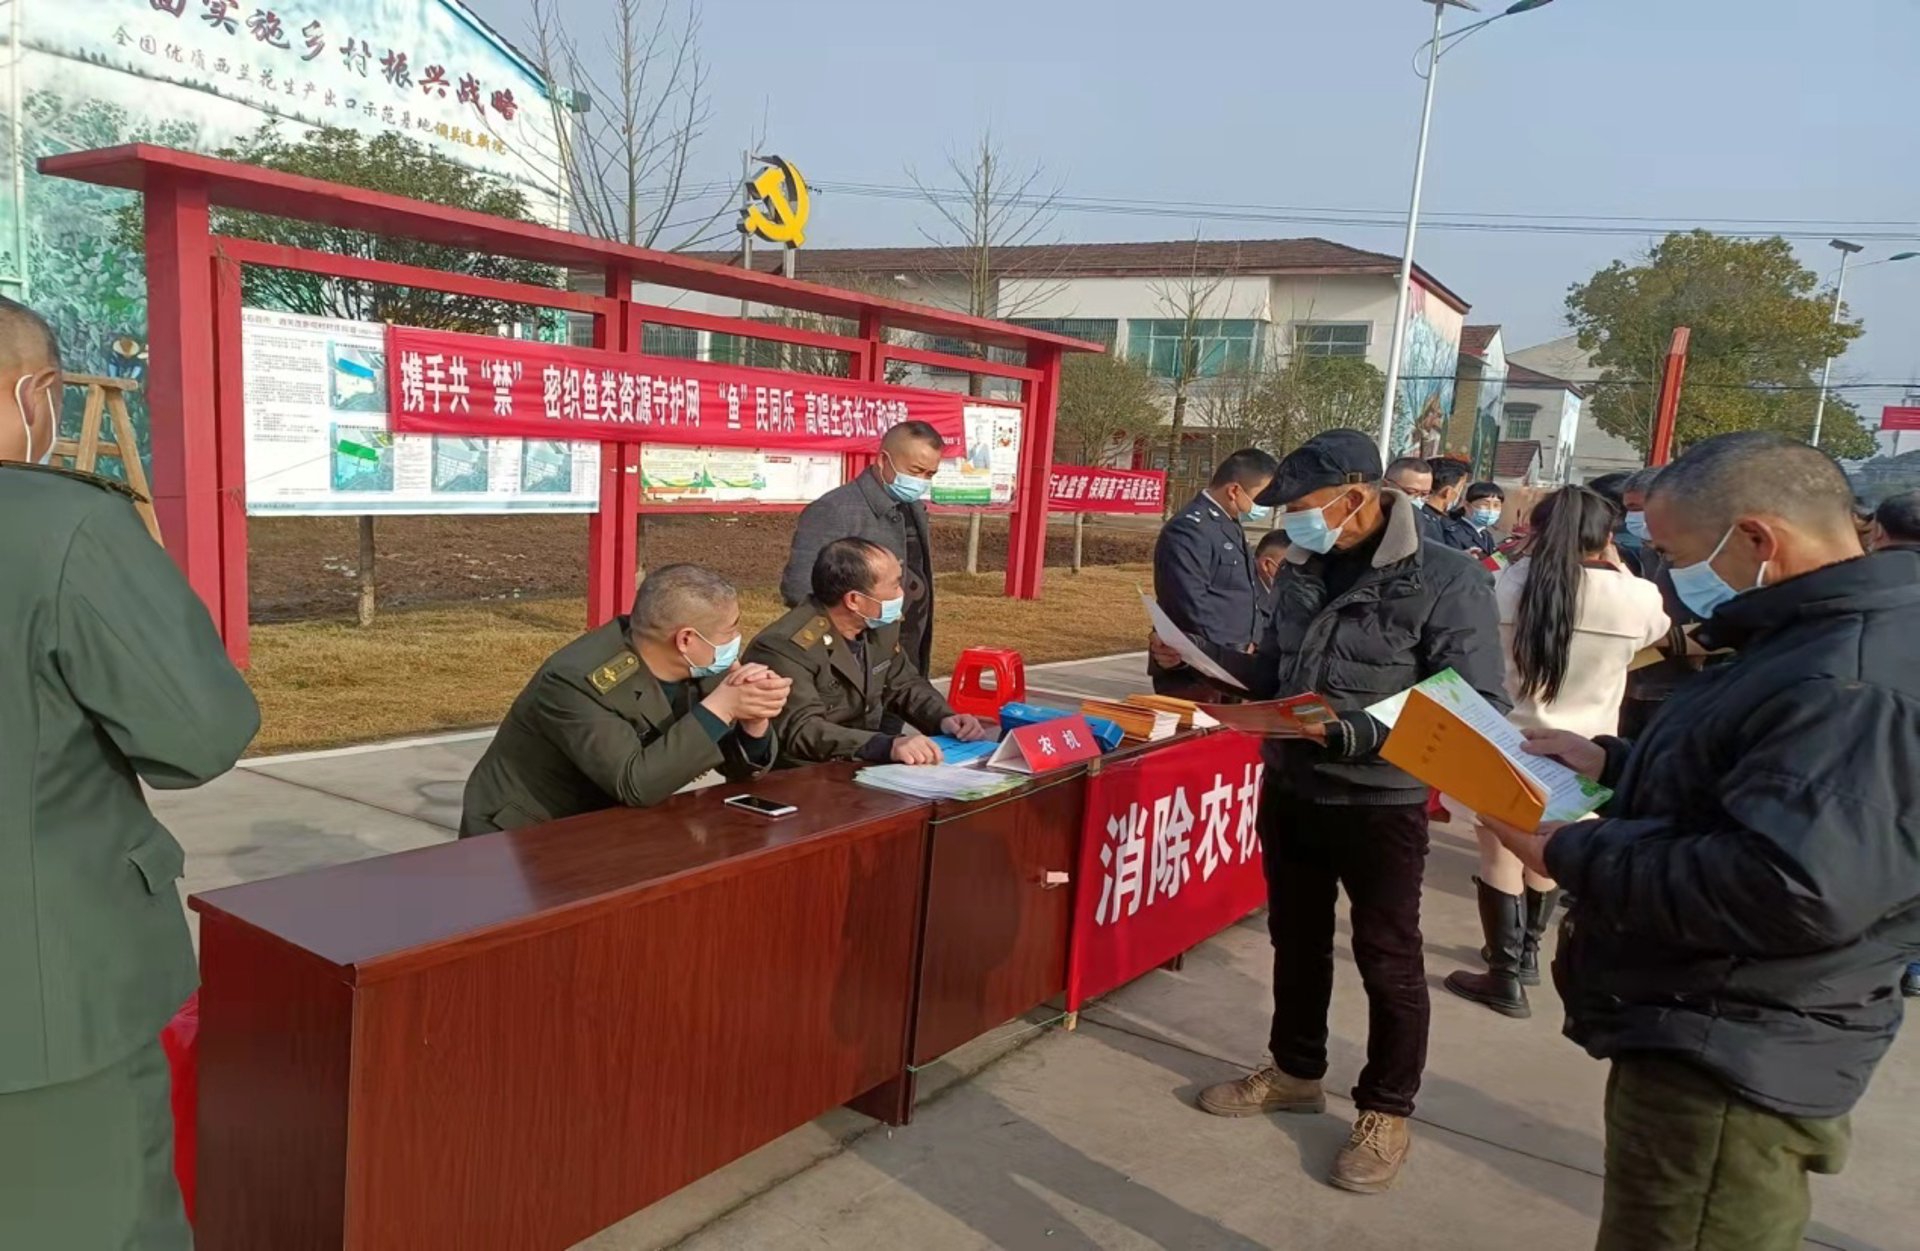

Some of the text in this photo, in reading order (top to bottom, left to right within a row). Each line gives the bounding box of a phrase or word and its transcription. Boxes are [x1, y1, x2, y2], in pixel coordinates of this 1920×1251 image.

[111, 25, 433, 133] 全国优质西兰花生产出口示范基地
[542, 364, 701, 428] 密织鱼类资源守护网
[1037, 729, 1082, 756] 农机
[1095, 762, 1265, 927] 消除农机
